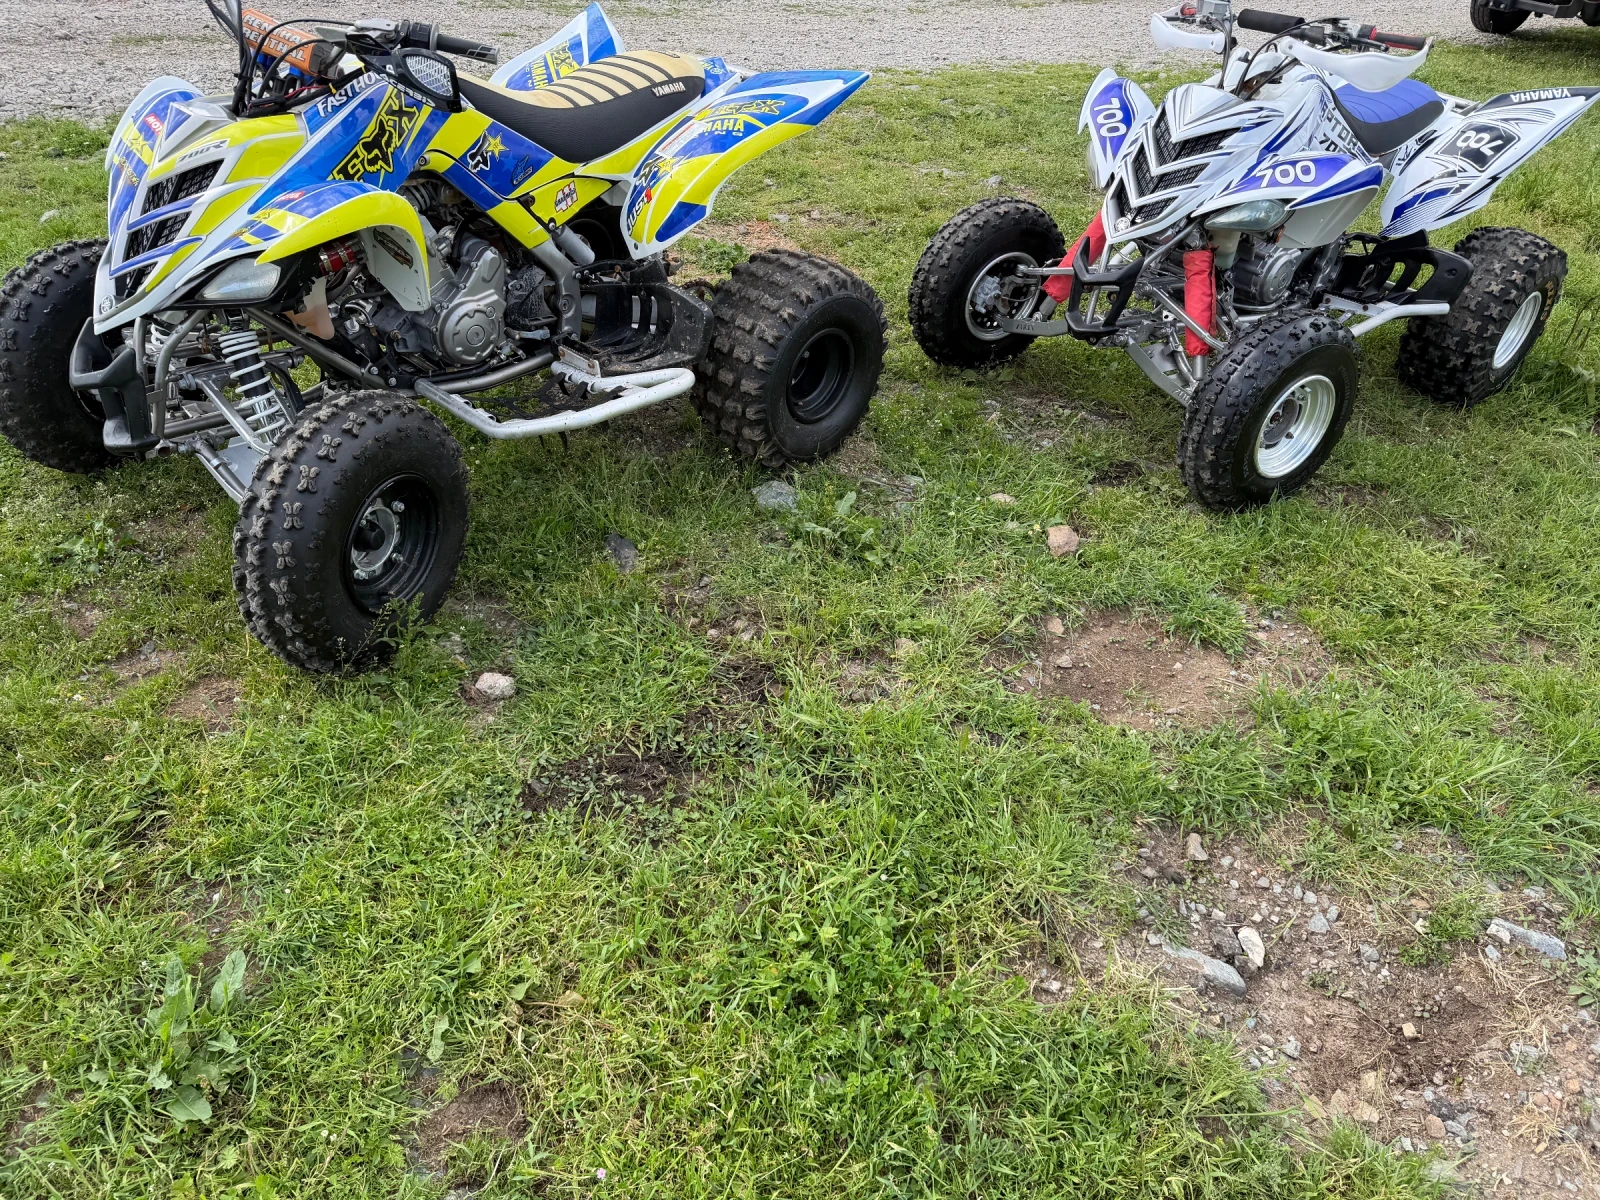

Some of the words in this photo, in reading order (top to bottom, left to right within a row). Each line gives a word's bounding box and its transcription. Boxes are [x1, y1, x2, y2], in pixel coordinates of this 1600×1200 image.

[652, 82, 686, 97] YAMAHA
[1510, 88, 1572, 103] YAMAHA
[145, 115, 164, 135] MOT
[703, 118, 745, 133] MAHA
[1093, 97, 1127, 137] 700
[1456, 130, 1504, 157] 700
[1255, 160, 1316, 188] 700
